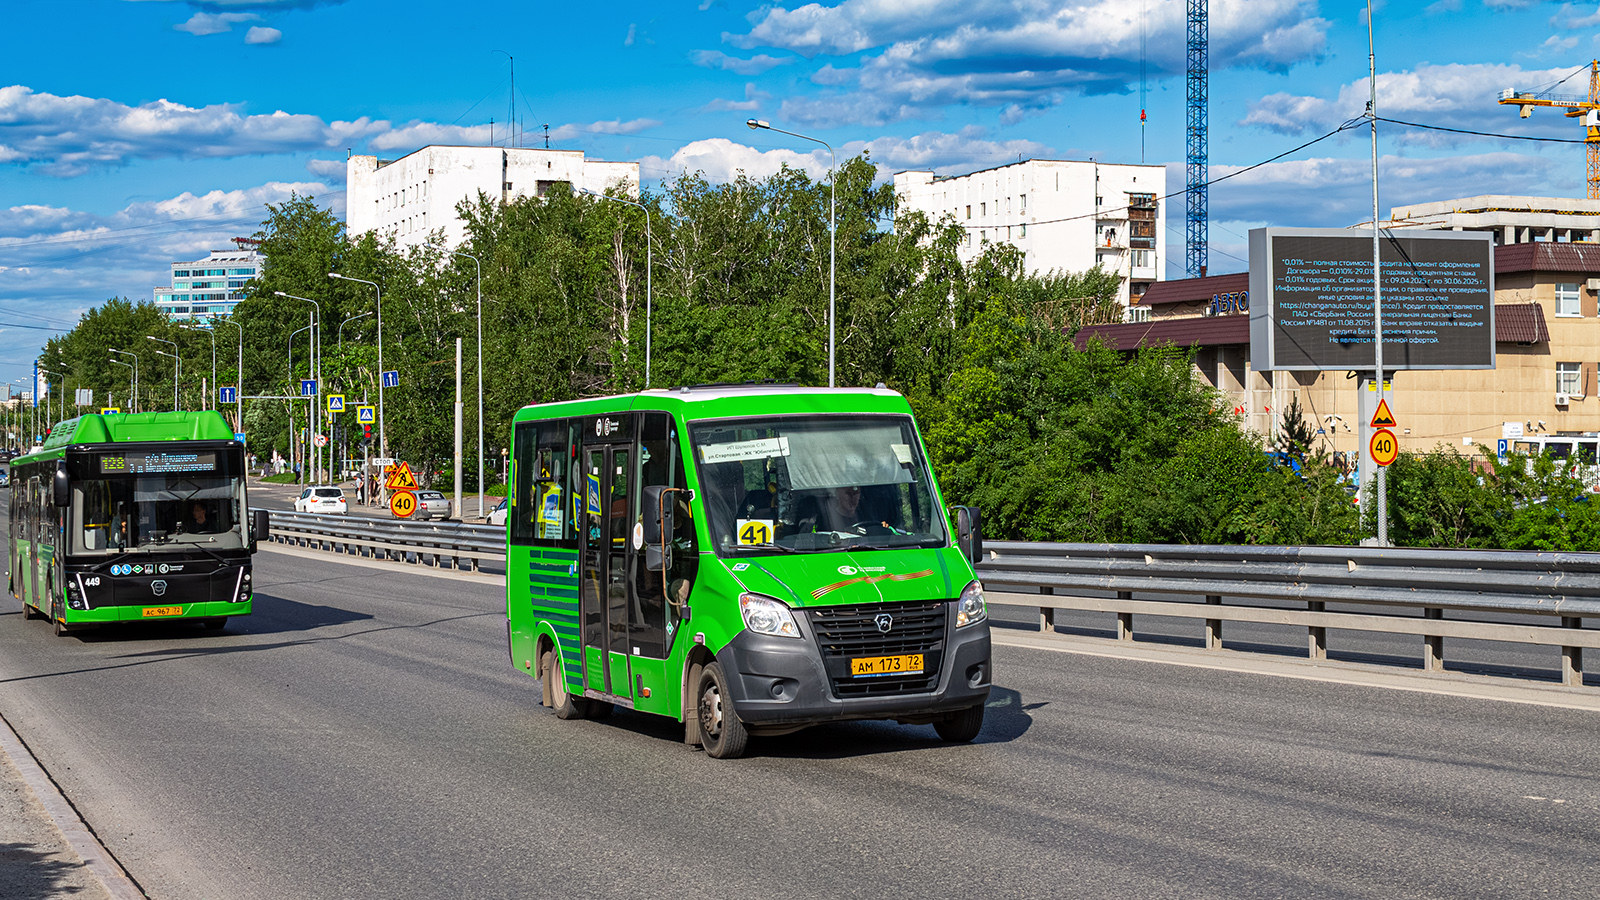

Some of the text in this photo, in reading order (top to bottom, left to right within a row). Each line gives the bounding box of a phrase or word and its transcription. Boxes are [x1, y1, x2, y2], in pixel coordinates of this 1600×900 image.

[1275, 284, 1321, 292] Информация
[1210, 291, 1249, 314] АВТО
[1376, 440, 1391, 454] 40
[1500, 441, 1506, 456] P
[102, 457, 124, 470] 128
[395, 498, 410, 510] 40
[742, 526, 766, 544] 41
[85, 577, 101, 586] 449
[858, 656, 919, 672] АМ 173 72
